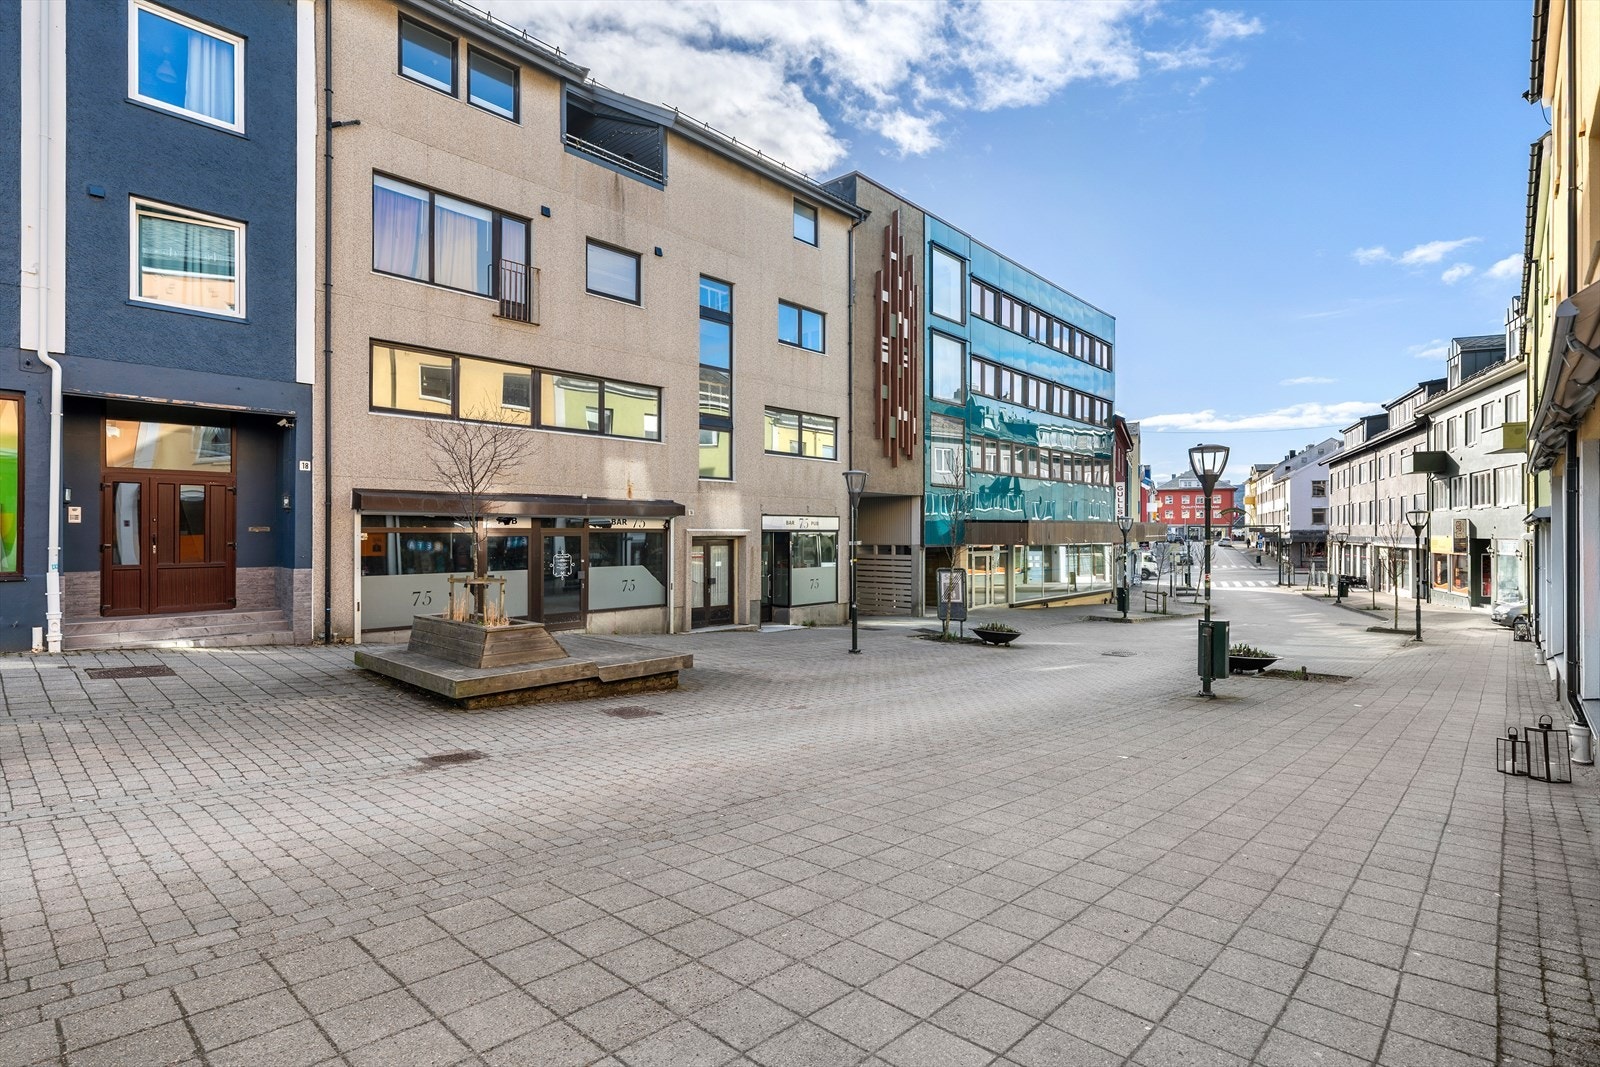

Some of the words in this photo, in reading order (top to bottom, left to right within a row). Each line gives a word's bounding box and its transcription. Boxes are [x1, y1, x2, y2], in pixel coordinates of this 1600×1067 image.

[611, 518, 628, 526] BAR
[799, 518, 809, 529] 75
[621, 579, 636, 593] 75
[810, 578, 819, 590] 75
[412, 590, 432, 607] 75
